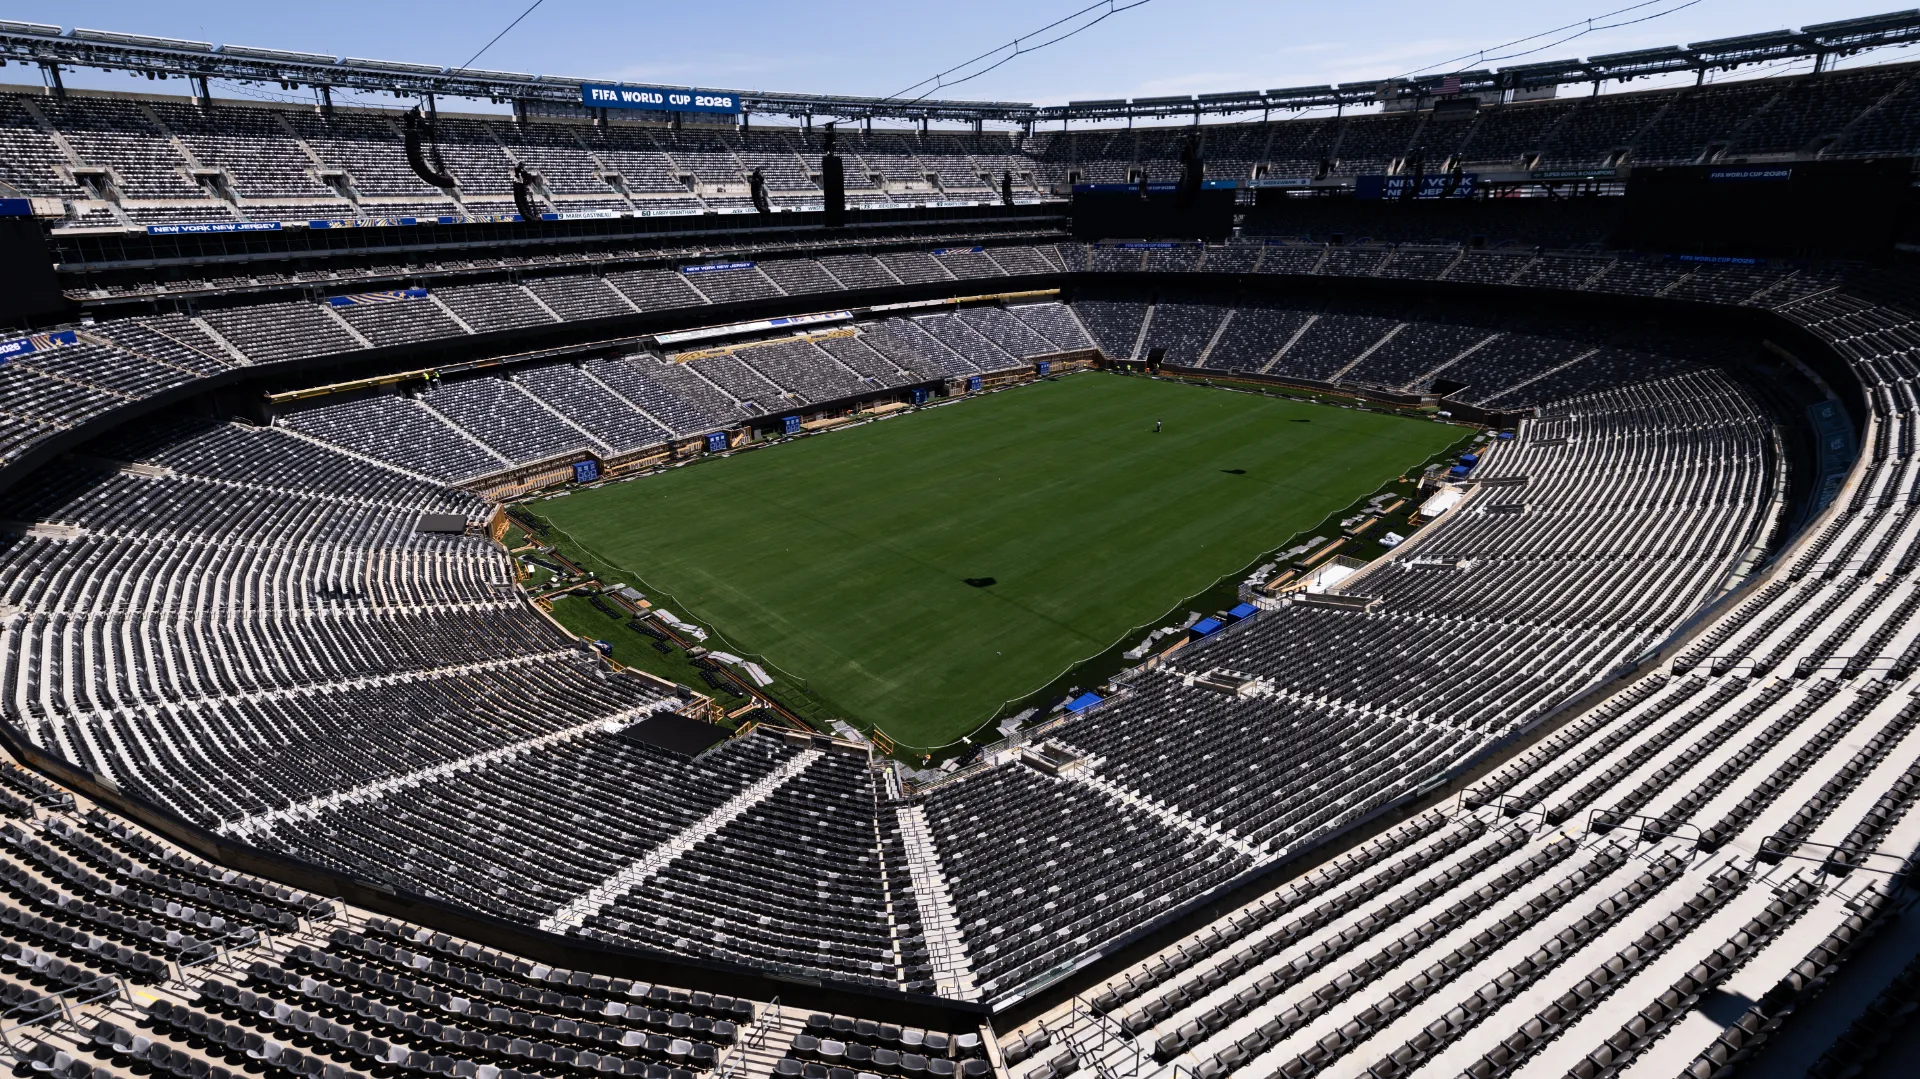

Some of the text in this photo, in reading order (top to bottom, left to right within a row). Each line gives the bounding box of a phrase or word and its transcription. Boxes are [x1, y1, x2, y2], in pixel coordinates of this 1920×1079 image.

[592, 89, 732, 108] FIFA WORLD CUP 2026
[1428, 178, 1472, 187] YOK
[1419, 188, 1472, 196] JEREY
